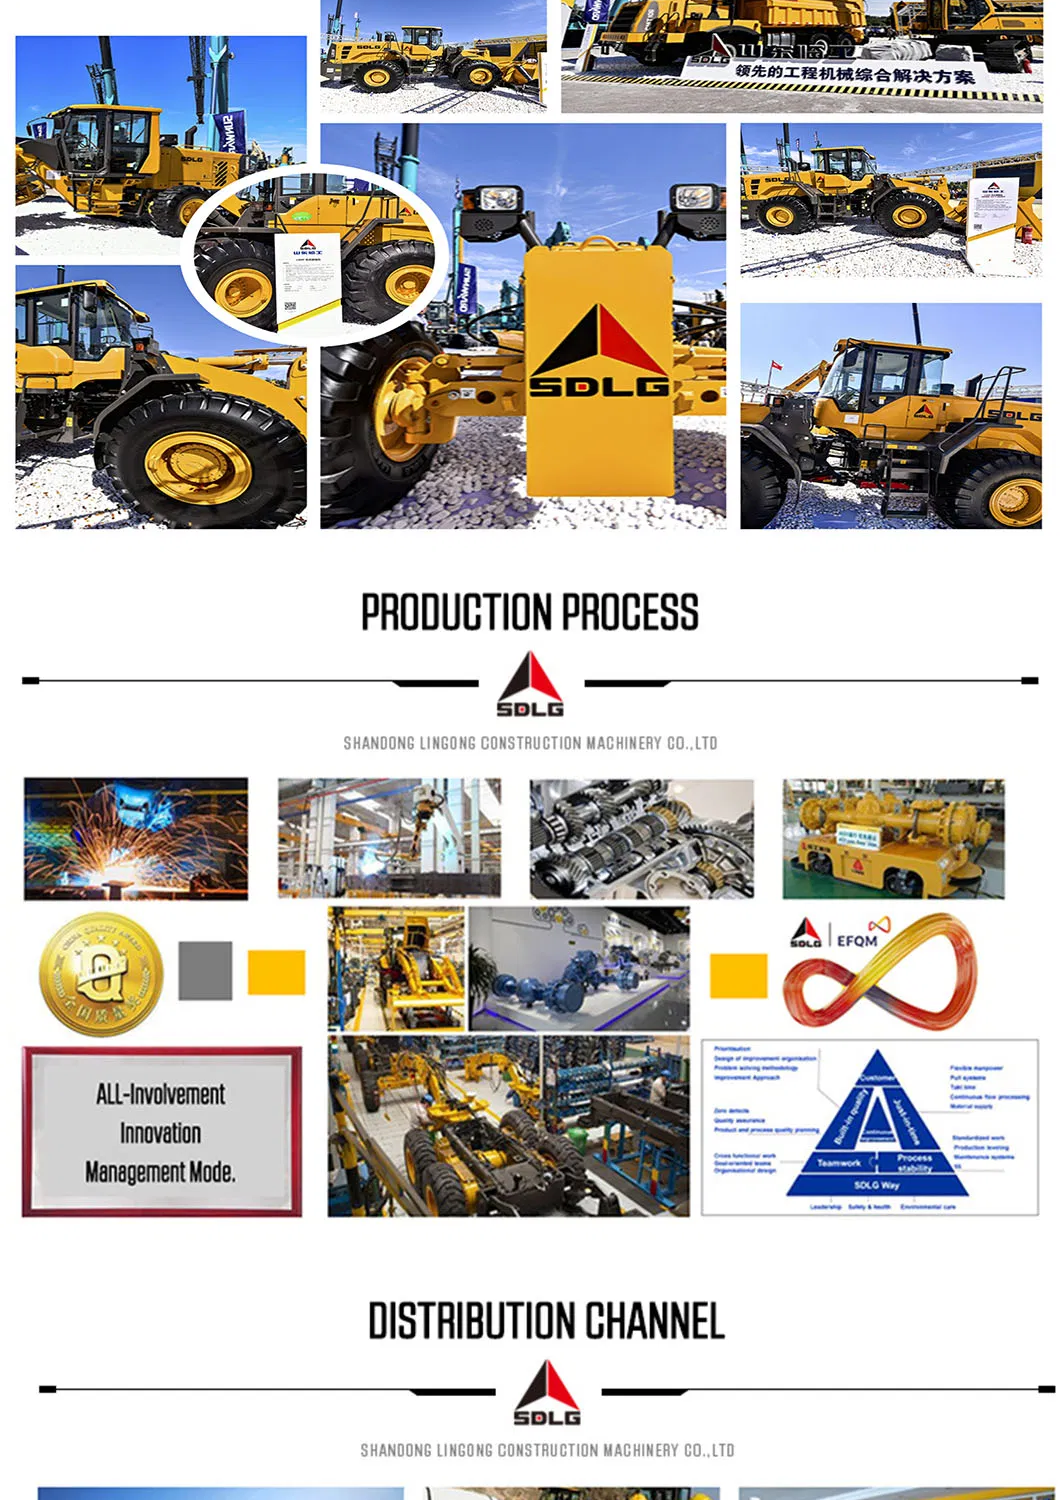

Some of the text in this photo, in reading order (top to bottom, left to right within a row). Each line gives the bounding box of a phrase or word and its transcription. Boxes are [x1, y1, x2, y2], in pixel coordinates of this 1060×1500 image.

[690, 55, 731, 64] SDLG
[735, 62, 977, 86] 领先的工程机械综合解决方案
[529, 376, 670, 398] SDLG
[987, 409, 1043, 422] SDLG
[96, 1082, 226, 1105] ALL-Involvement
[120, 1121, 201, 1144] Innovation
[817, 1158, 862, 1167] Teamwork
[897, 1154, 933, 1162] Process
[85, 1160, 236, 1187] Management Mode.
[897, 1164, 934, 1174] stability
[854, 1181, 901, 1192] SDLG Way
